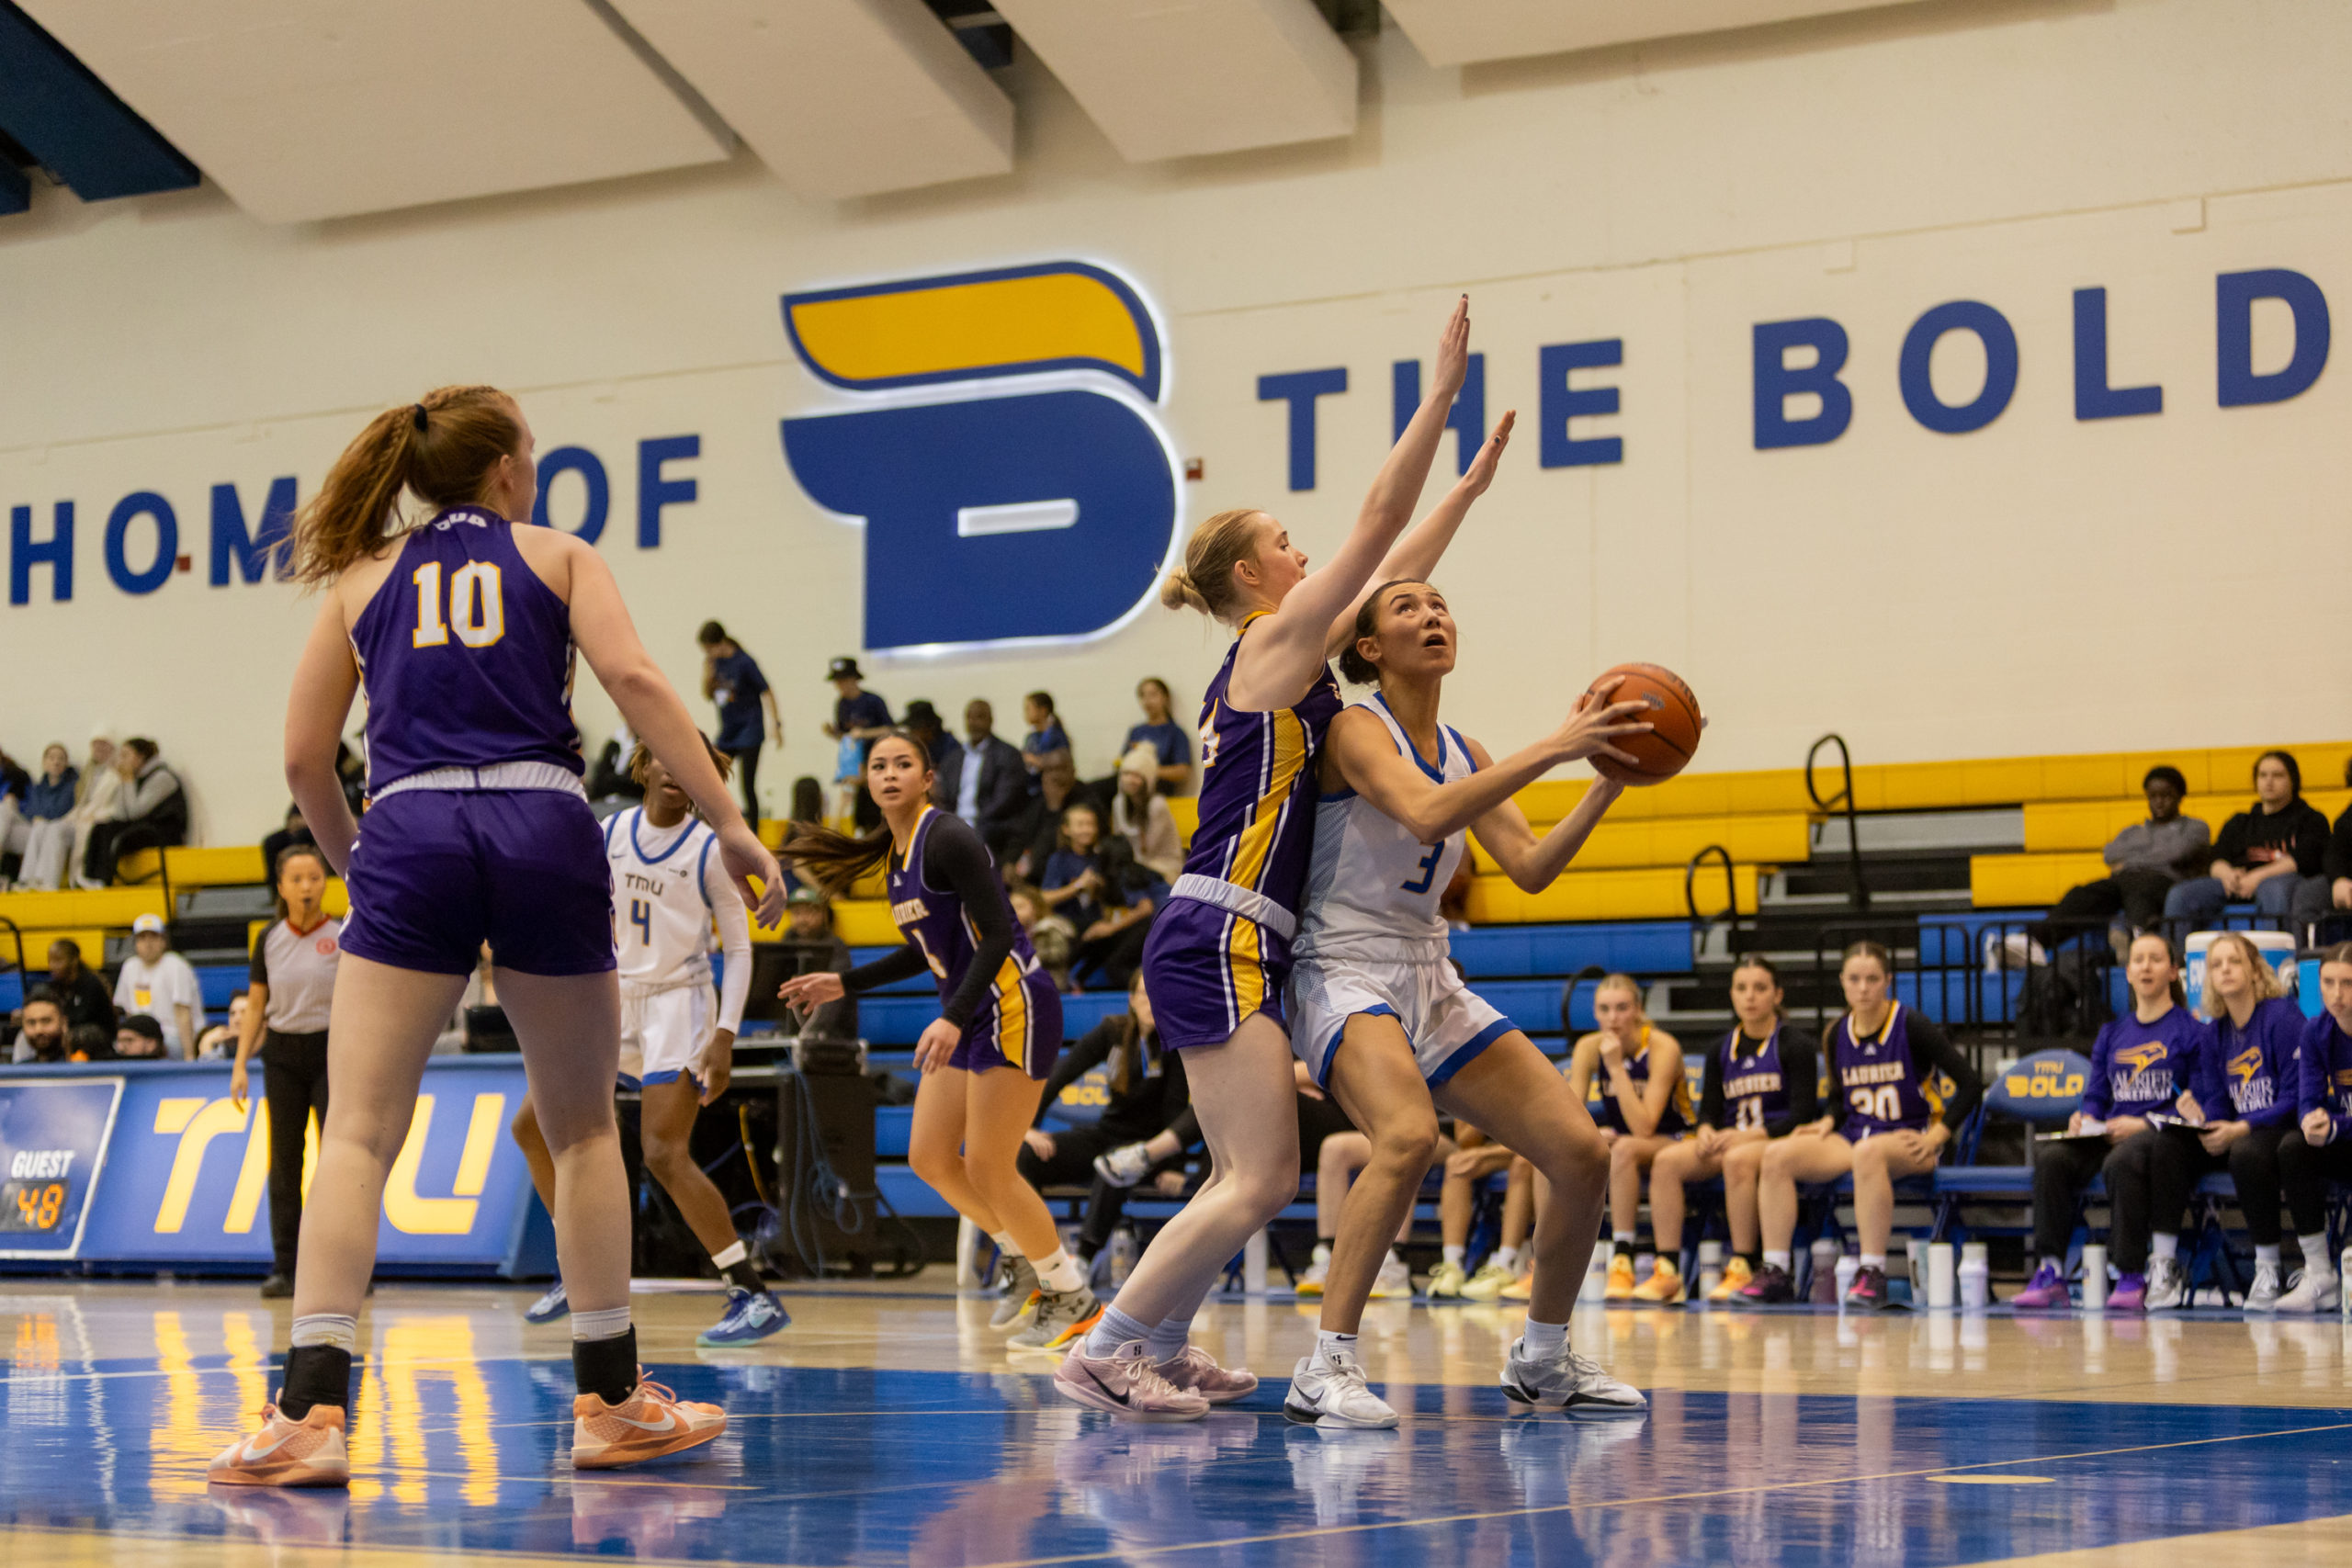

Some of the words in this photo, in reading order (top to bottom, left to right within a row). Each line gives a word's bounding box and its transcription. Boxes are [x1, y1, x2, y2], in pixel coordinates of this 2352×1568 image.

[1257, 337, 1623, 491] THE
[1752, 267, 2332, 450] BOLD
[10, 474, 298, 606] HOM
[531, 434, 699, 550] OF
[413, 558, 505, 649] 10
[625, 873, 663, 897] TMU
[1399, 838, 1446, 896] 3
[630, 897, 650, 947] 4
[1058, 1084, 1112, 1106] BOL
[1841, 1060, 1905, 1087] LAURIER
[2005, 1073, 2084, 1098] BOLD
[11, 1149, 75, 1179] GUEST
[17, 1183, 64, 1229] 48
